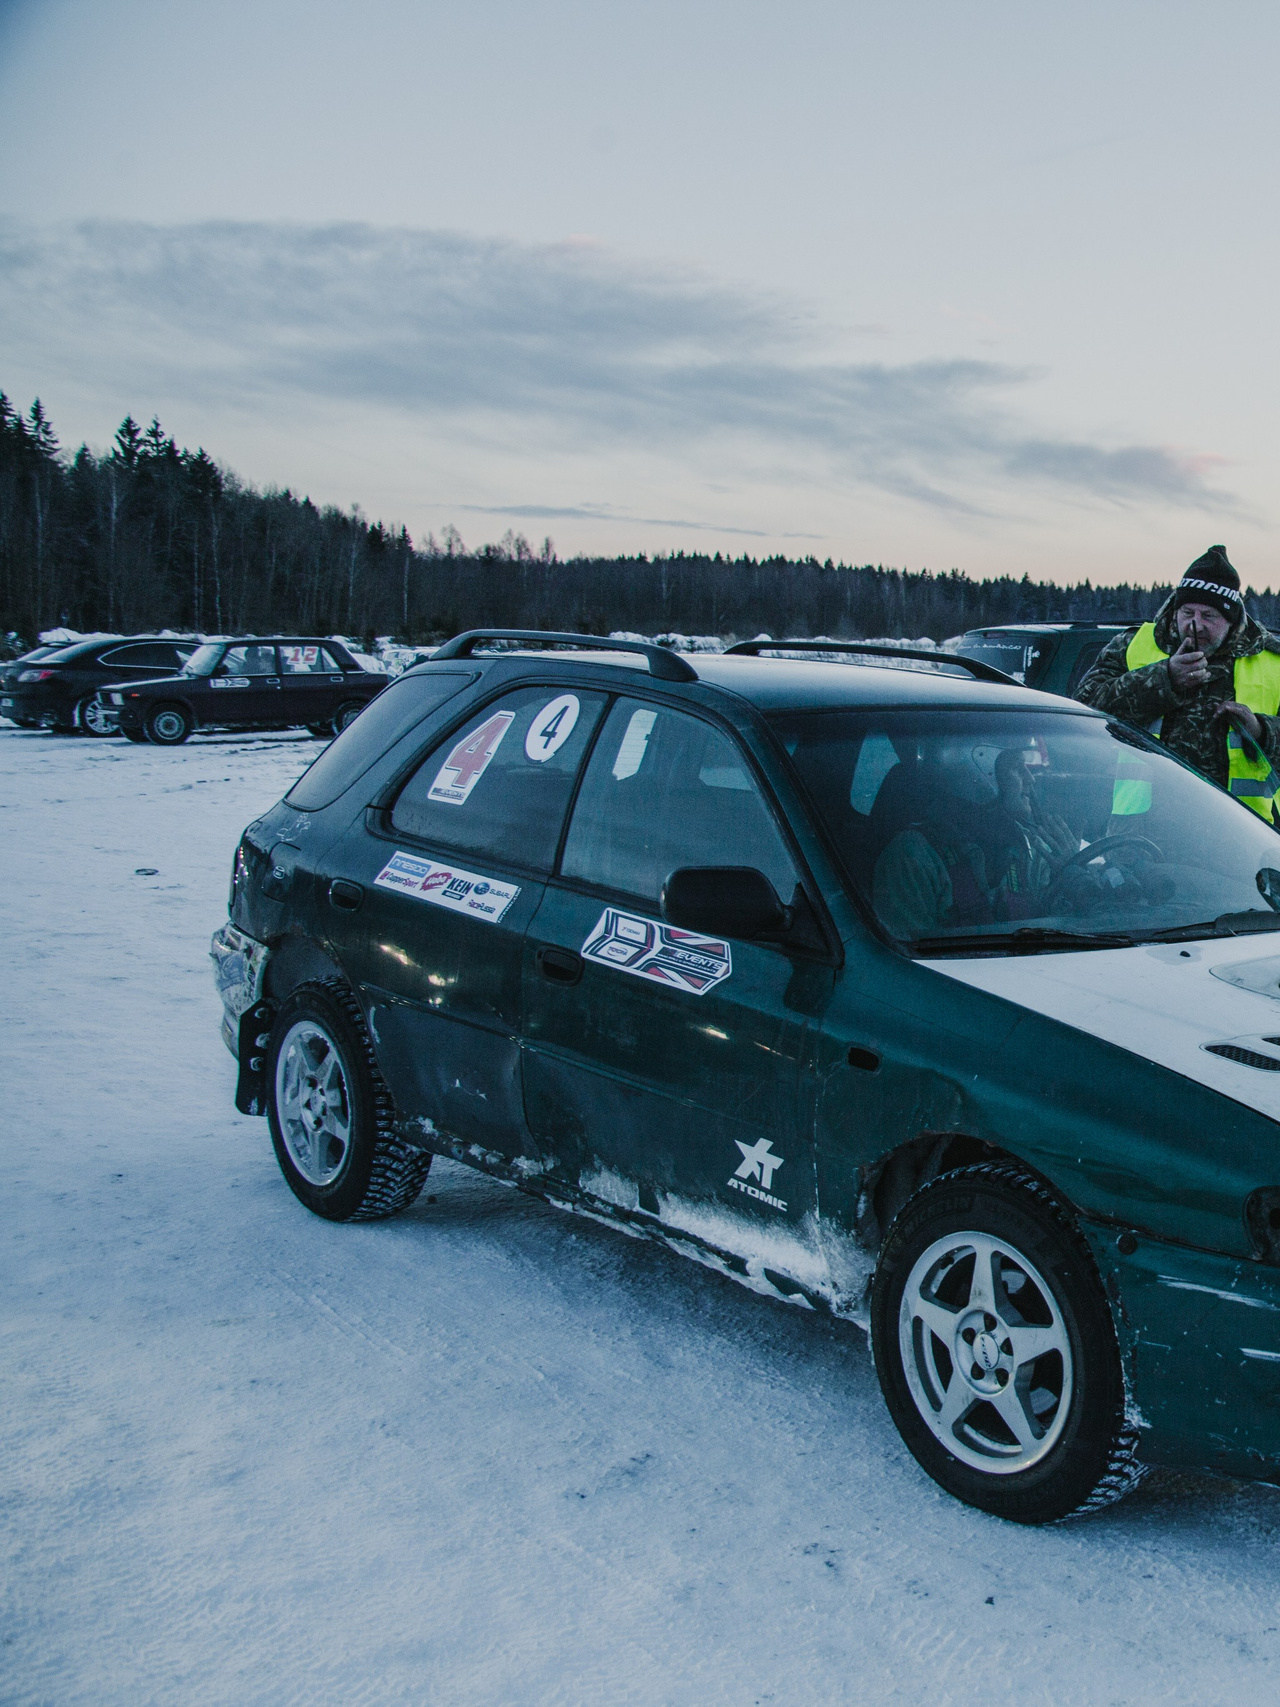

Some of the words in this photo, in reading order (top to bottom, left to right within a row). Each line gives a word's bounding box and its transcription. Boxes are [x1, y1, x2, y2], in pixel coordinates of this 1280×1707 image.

[290, 648, 318, 662] 12
[540, 705, 570, 750] 4
[445, 713, 511, 788] 4
[446, 877, 475, 895] KEIN
[489, 887, 513, 900] SUBARU
[676, 951, 724, 970] EVENTS
[727, 1178, 788, 1212] ATOMIC
